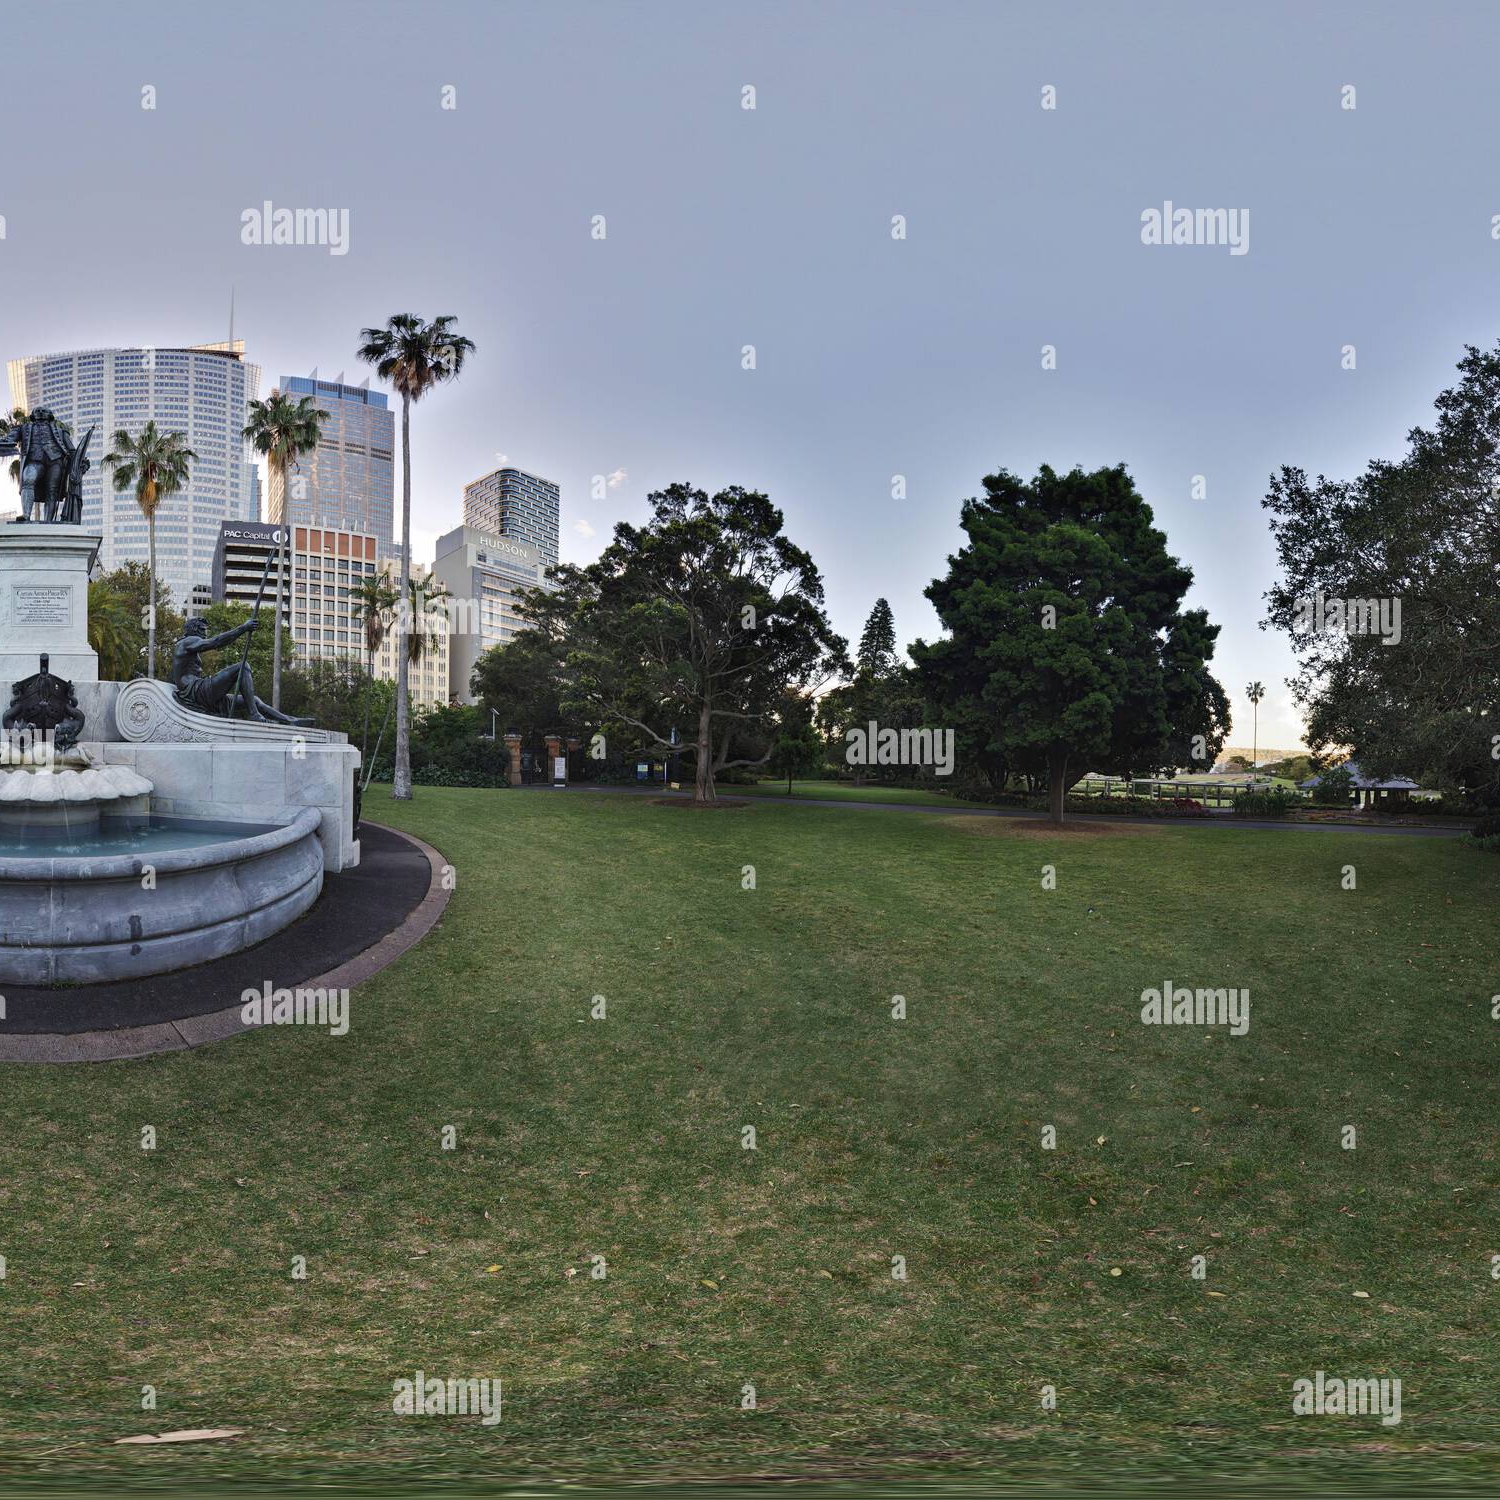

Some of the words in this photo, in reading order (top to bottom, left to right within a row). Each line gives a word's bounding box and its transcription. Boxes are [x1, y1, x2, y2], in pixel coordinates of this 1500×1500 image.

[224, 530, 241, 538] PAC
[243, 531, 270, 540] Capital
[480, 536, 527, 558] HUDSON
